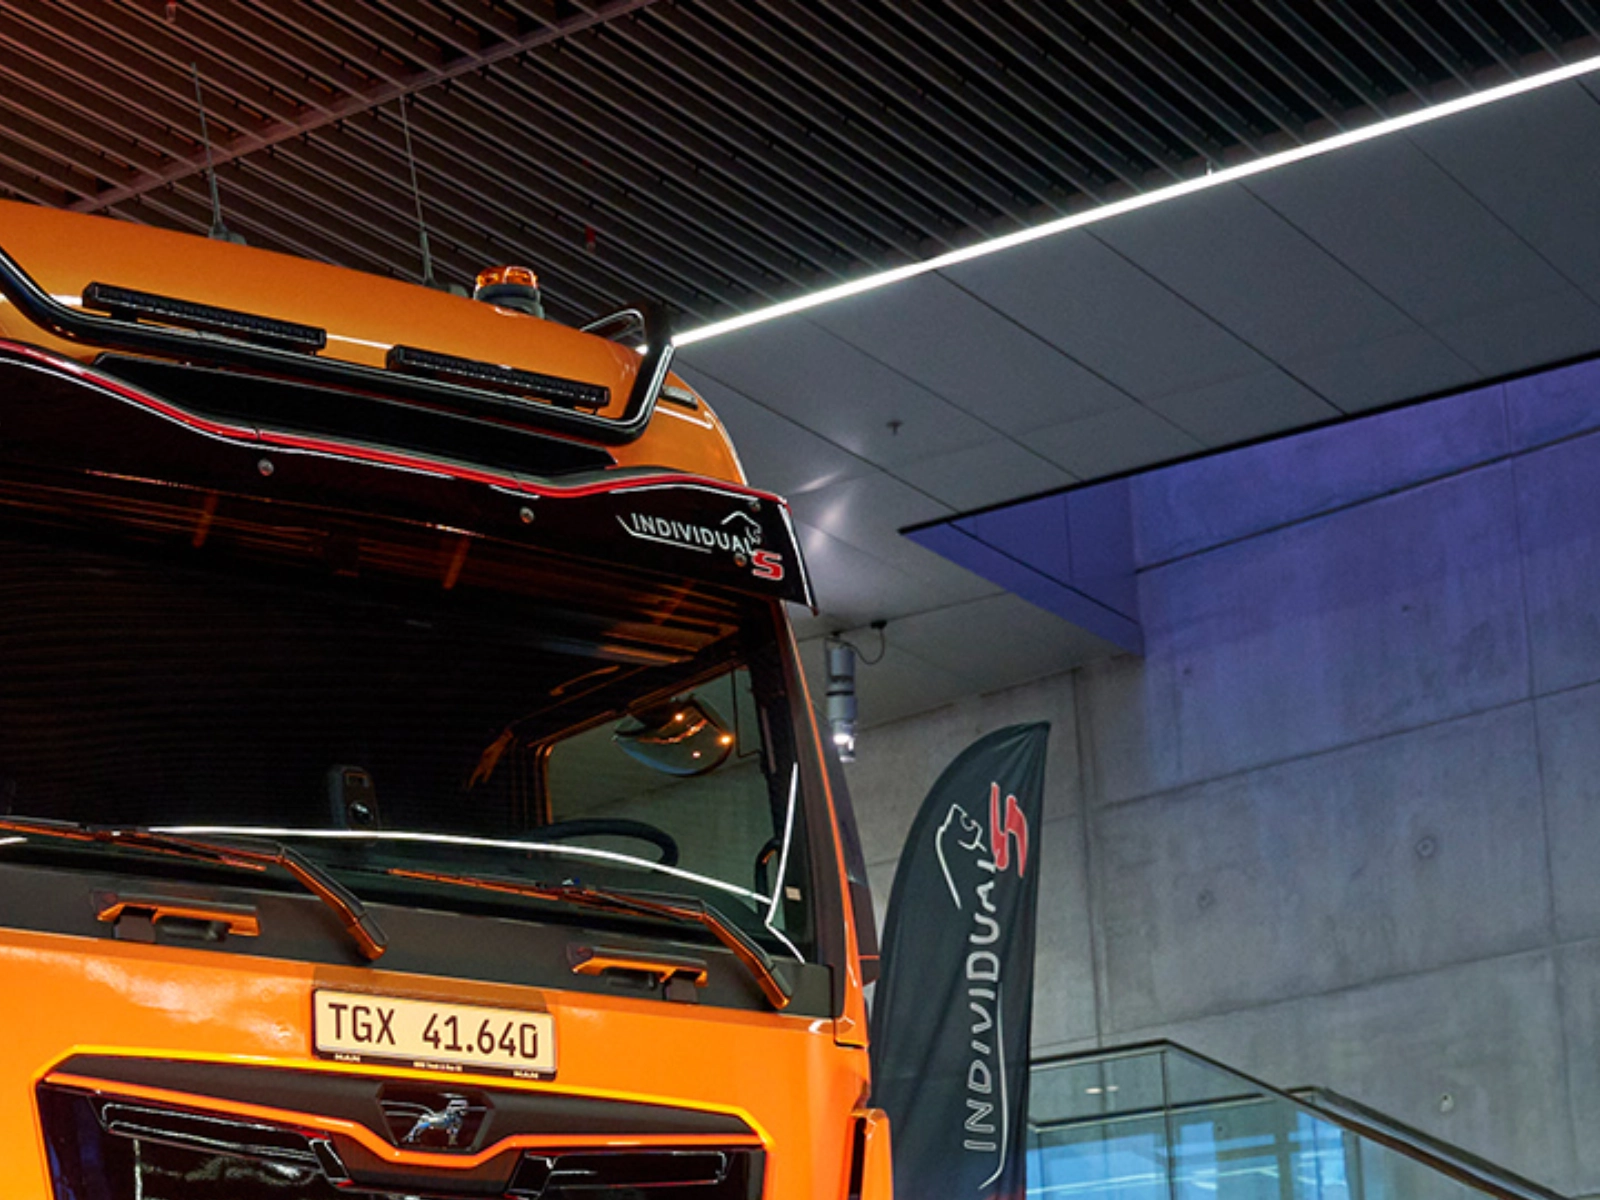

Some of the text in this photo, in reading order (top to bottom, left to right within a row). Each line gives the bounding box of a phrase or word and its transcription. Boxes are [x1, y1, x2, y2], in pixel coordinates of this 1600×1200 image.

[631, 513, 785, 581] INDIVIDUAL S
[328, 1003, 539, 1060] TGX 41.640
[964, 859, 1001, 1153] INDIVIDUAL
